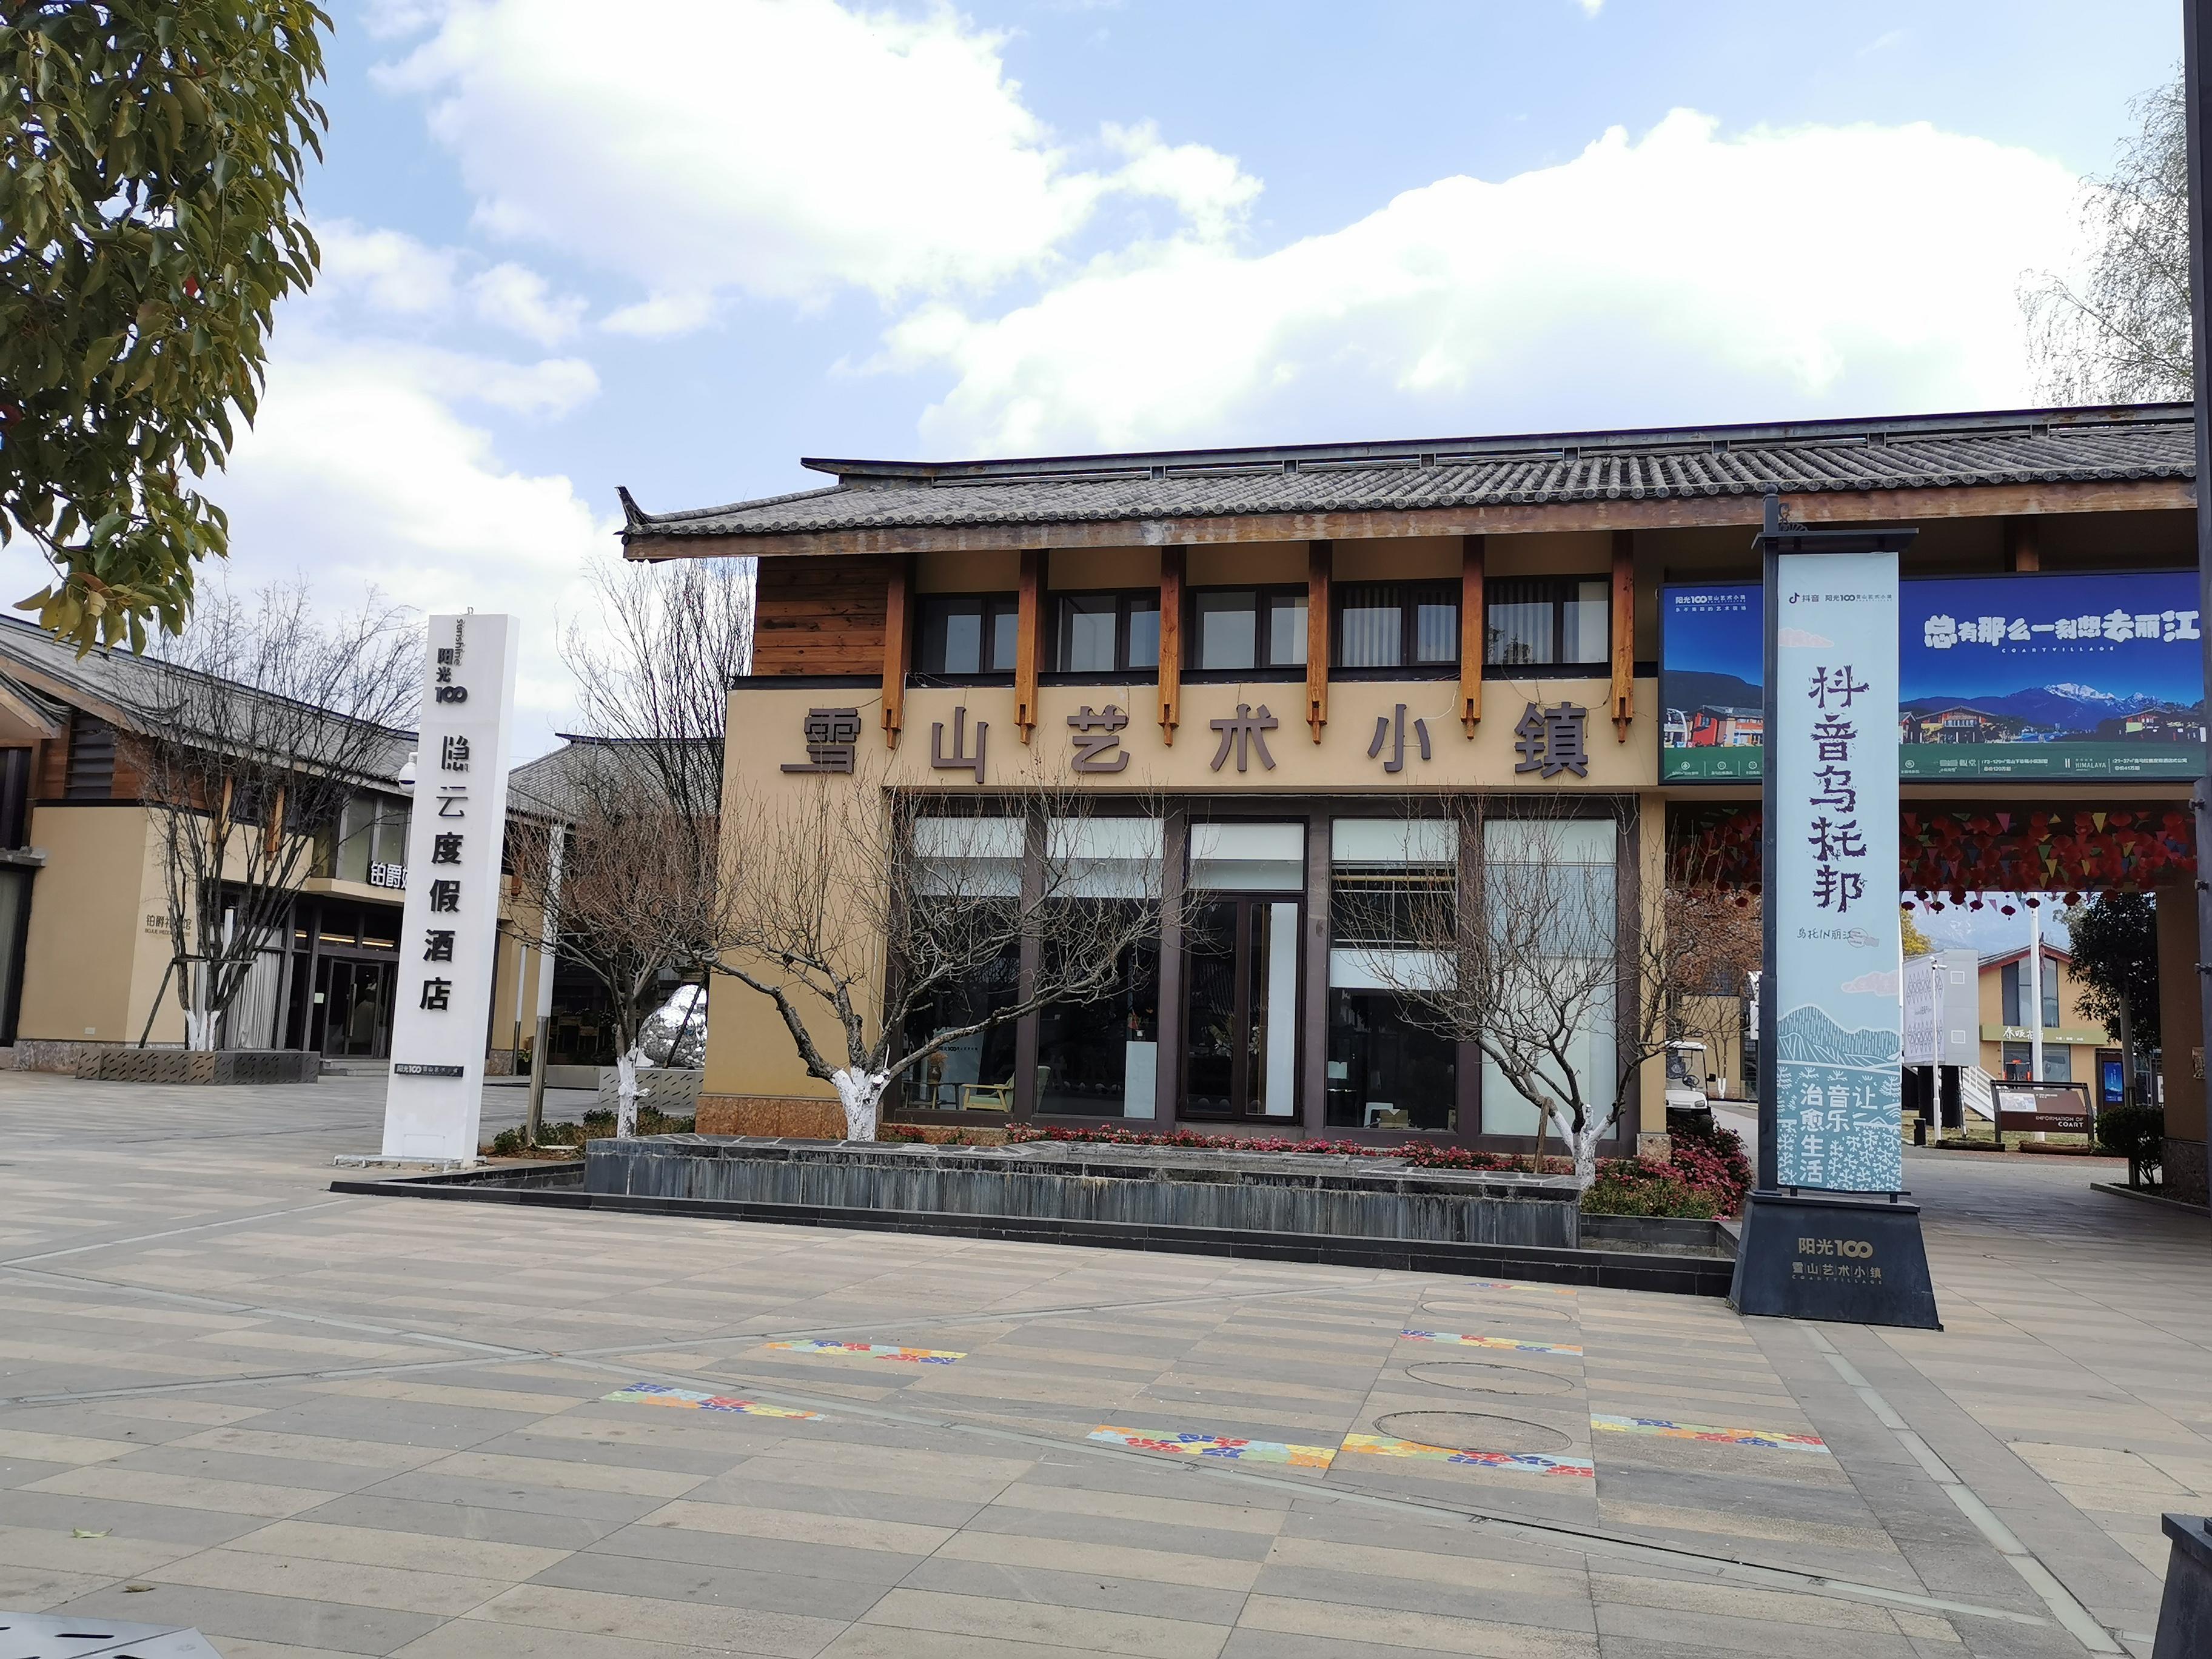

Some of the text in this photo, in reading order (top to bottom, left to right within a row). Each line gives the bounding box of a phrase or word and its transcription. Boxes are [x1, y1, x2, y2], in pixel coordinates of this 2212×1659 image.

[454, 618, 464, 666] sunshine
[1924, 609, 2200, 649] 总有那么一刻想去丽江
[1808, 665, 1870, 913] 抖音乌托邦
[419, 735, 471, 1011] 隐云度假酒店
[146, 914, 192, 930] 铂爵馆
[2003, 1026, 2043, 1041] 春暖花
[1825, 1084, 1850, 1133] 音乐
[1852, 1085, 1878, 1110] 让
[1800, 1082, 1825, 1183] 治愈生活
[1798, 1238, 1873, 1259] 阳光100
[1792, 1262, 1882, 1279] 雪山艺术小镇
